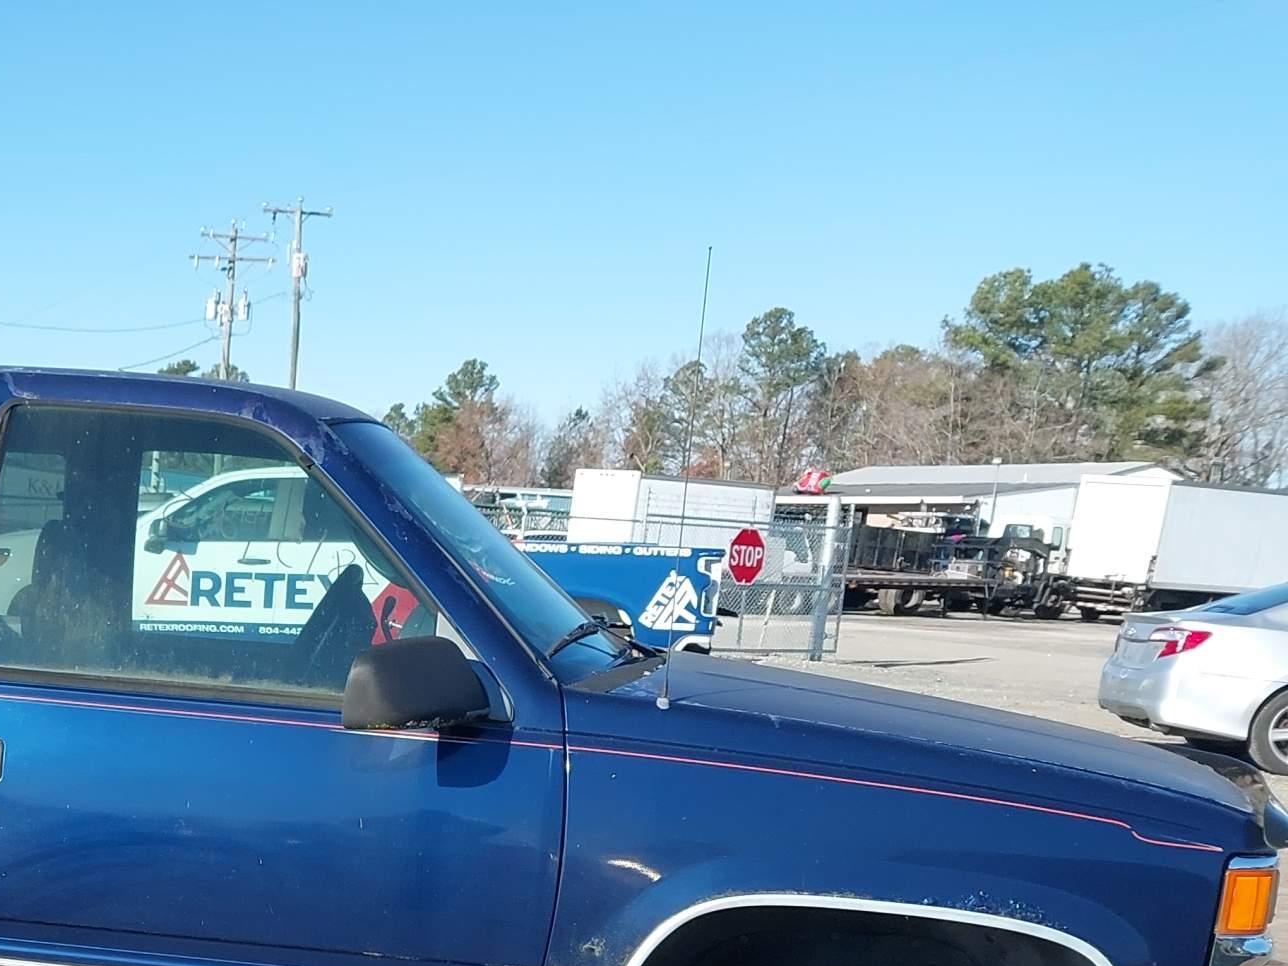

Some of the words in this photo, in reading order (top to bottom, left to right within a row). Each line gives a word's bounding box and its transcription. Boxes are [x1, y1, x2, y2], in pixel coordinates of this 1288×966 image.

[578, 545, 623, 555] SIDING
[633, 546, 692, 557] GUTTERS
[730, 544, 763, 568] STOP
[638, 569, 686, 628] RETEX
[139, 623, 245, 634] RETEXROOFING.COM
